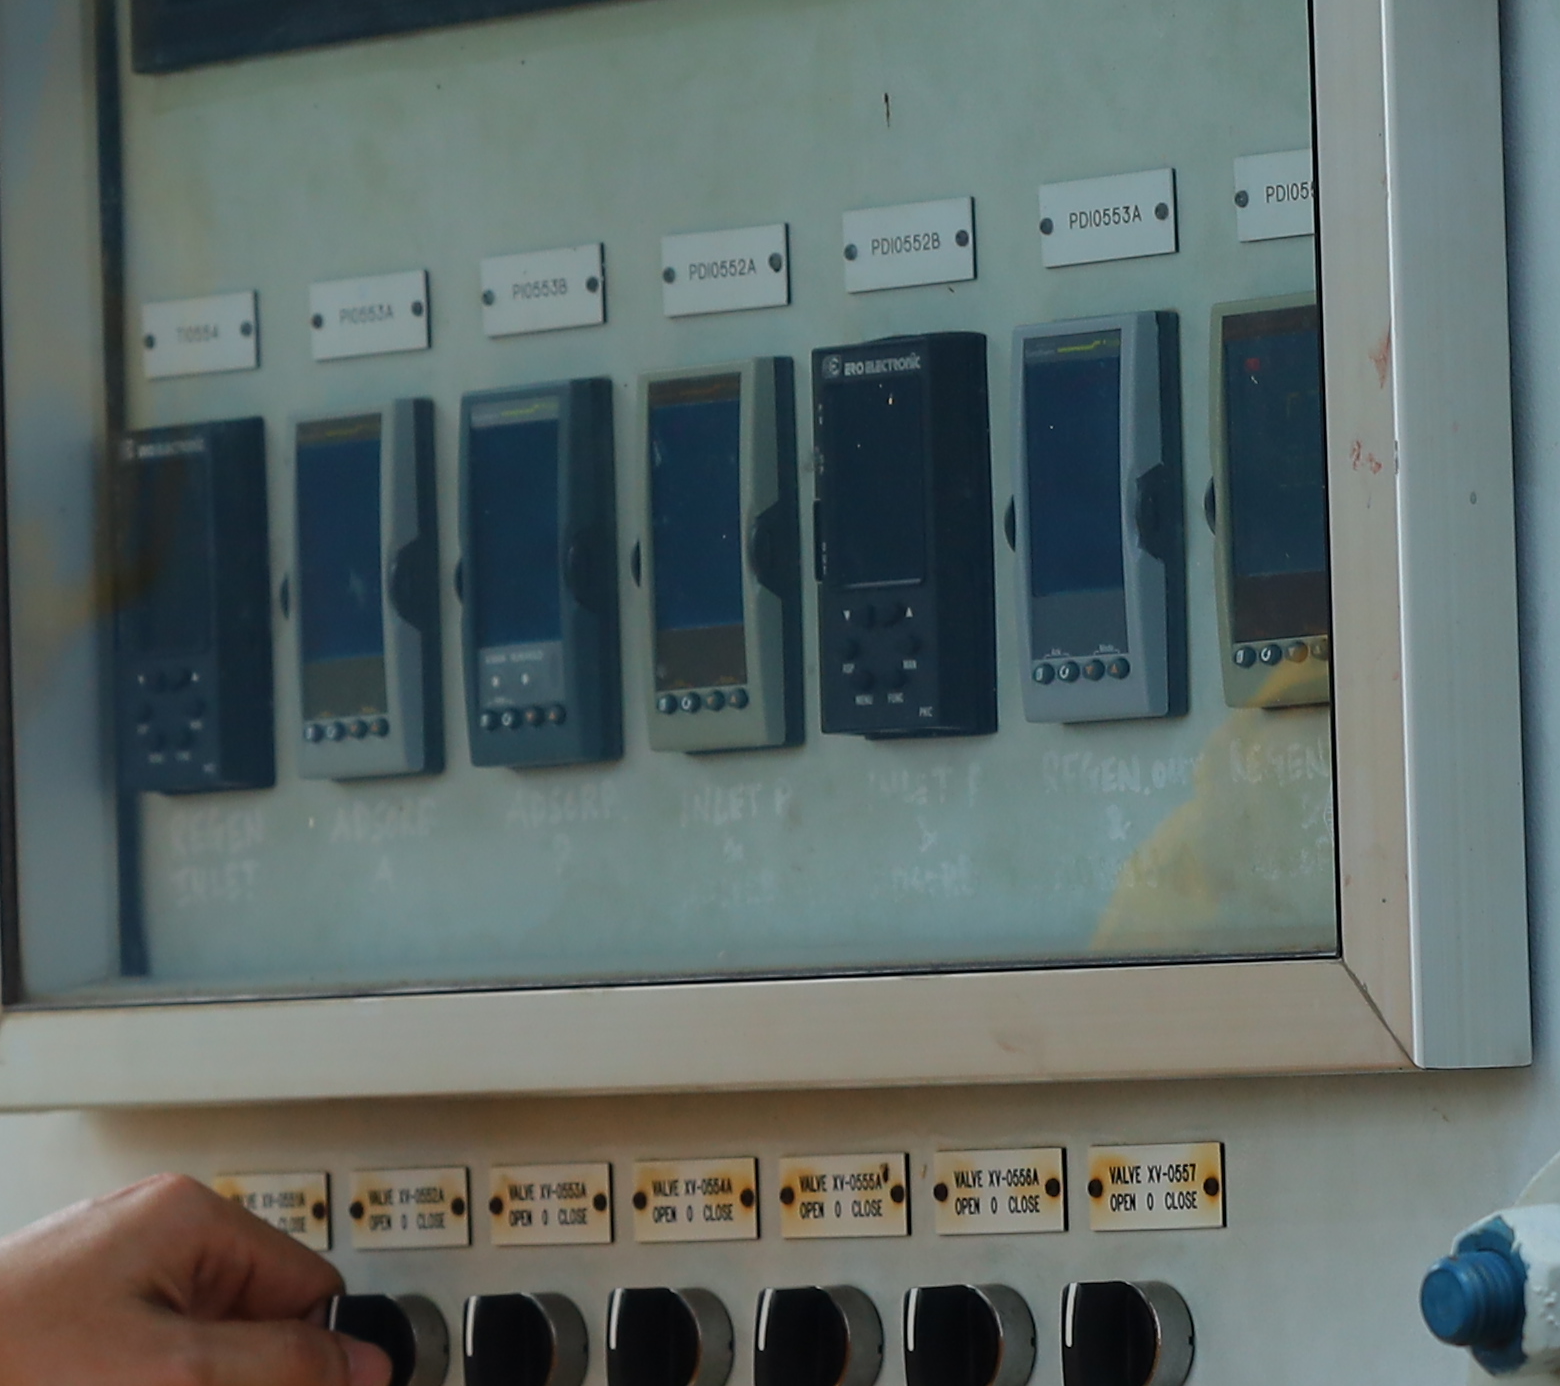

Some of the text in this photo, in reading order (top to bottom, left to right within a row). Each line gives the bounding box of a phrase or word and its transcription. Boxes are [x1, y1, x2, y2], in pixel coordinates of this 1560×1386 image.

[1068, 204, 1143, 231] PDI0553A
[870, 231, 941, 257] PDI0552B
[688, 257, 758, 281] PDI0552A
[799, 1176, 827, 1192] VALVE
[954, 1170, 983, 1188] VALVE
[1109, 1163, 1196, 1184] VALVE XV-0557
[651, 1180, 678, 1197] VALVE
[799, 1198, 883, 1219] OPEN CLOSE
[955, 1195, 1041, 1215] OPEN CLOSE
[1110, 1191, 1198, 1212] OPEN CLOSE
[652, 1203, 734, 1223] OPEN CLOSE
